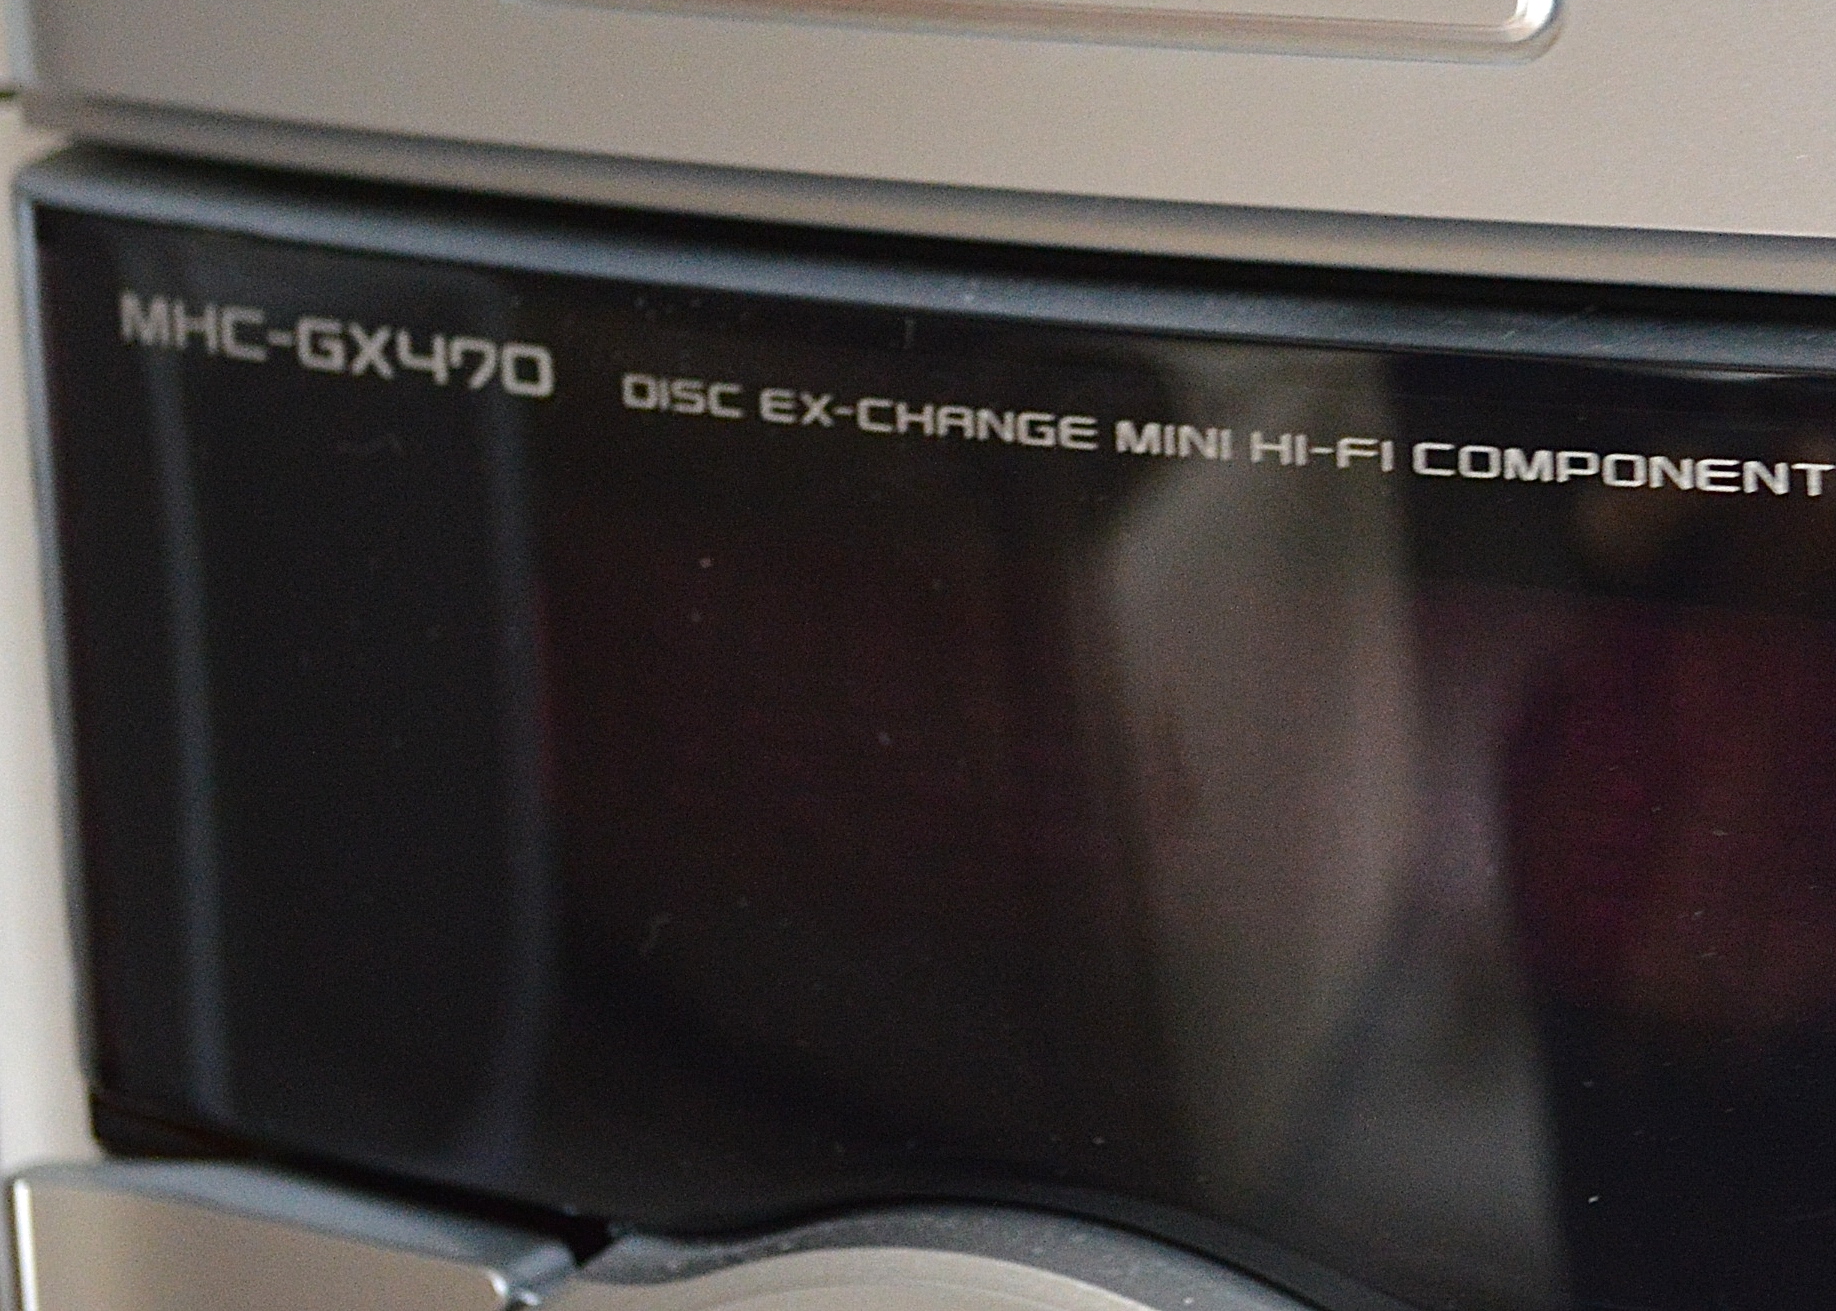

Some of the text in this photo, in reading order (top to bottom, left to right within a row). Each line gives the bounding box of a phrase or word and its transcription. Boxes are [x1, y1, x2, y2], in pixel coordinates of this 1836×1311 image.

[117, 288, 555, 399] MHC-GX470
[621, 372, 744, 420] DISC
[758, 387, 1099, 452] EX-CHANGE
[1114, 419, 1233, 462] MINI
[1249, 430, 1395, 473] HI-FI
[1411, 442, 1836, 497] COMPONENT
